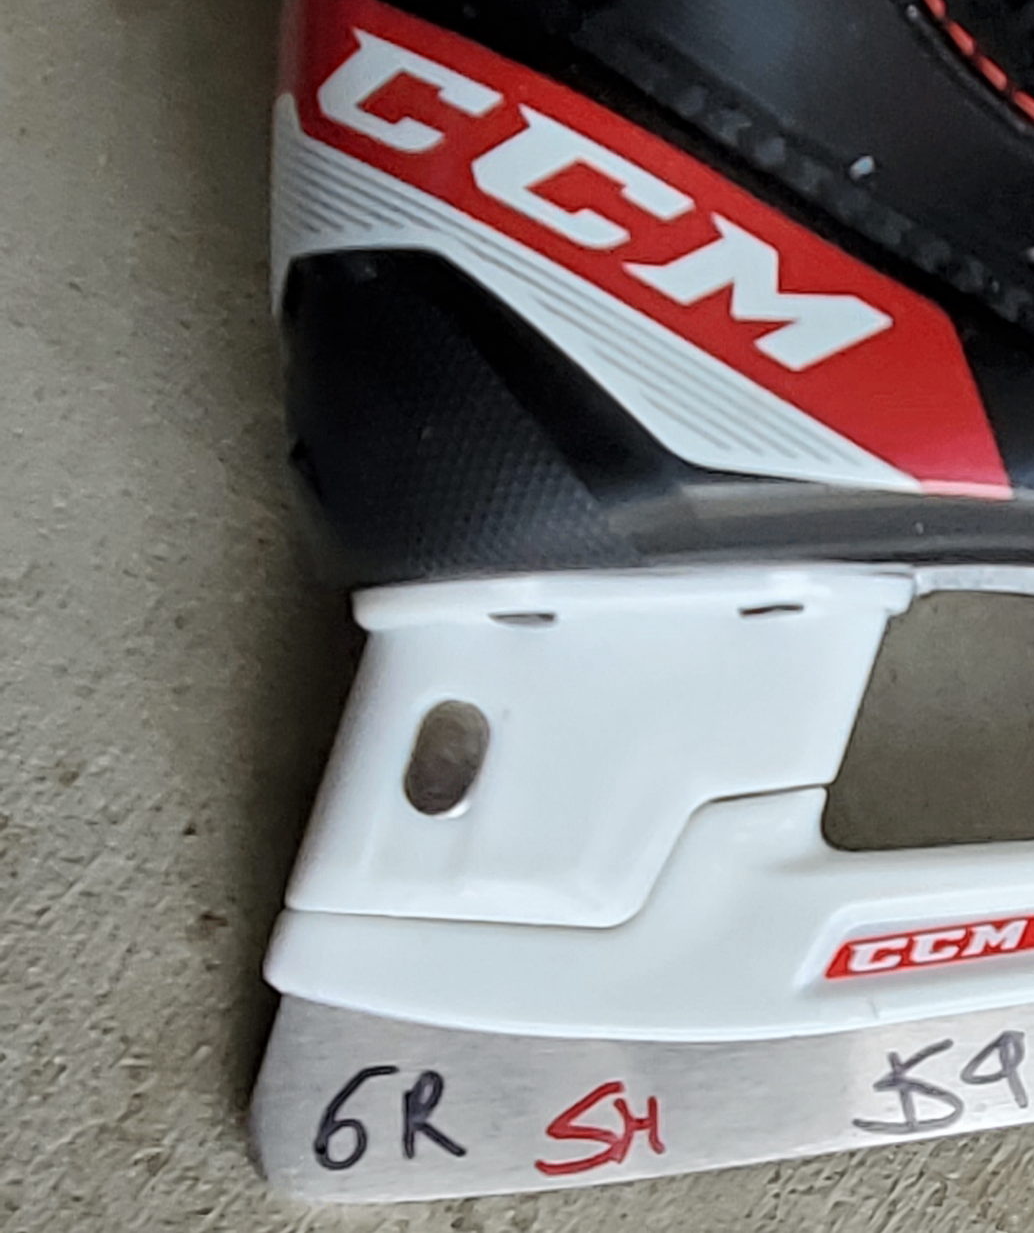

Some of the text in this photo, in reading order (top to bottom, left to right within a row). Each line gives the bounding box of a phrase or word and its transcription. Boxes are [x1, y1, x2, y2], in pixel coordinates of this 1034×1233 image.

[317, 26, 893, 372] CCM
[847, 919, 1028, 973] CCM
[314, 1065, 666, 1177] 6R SH
